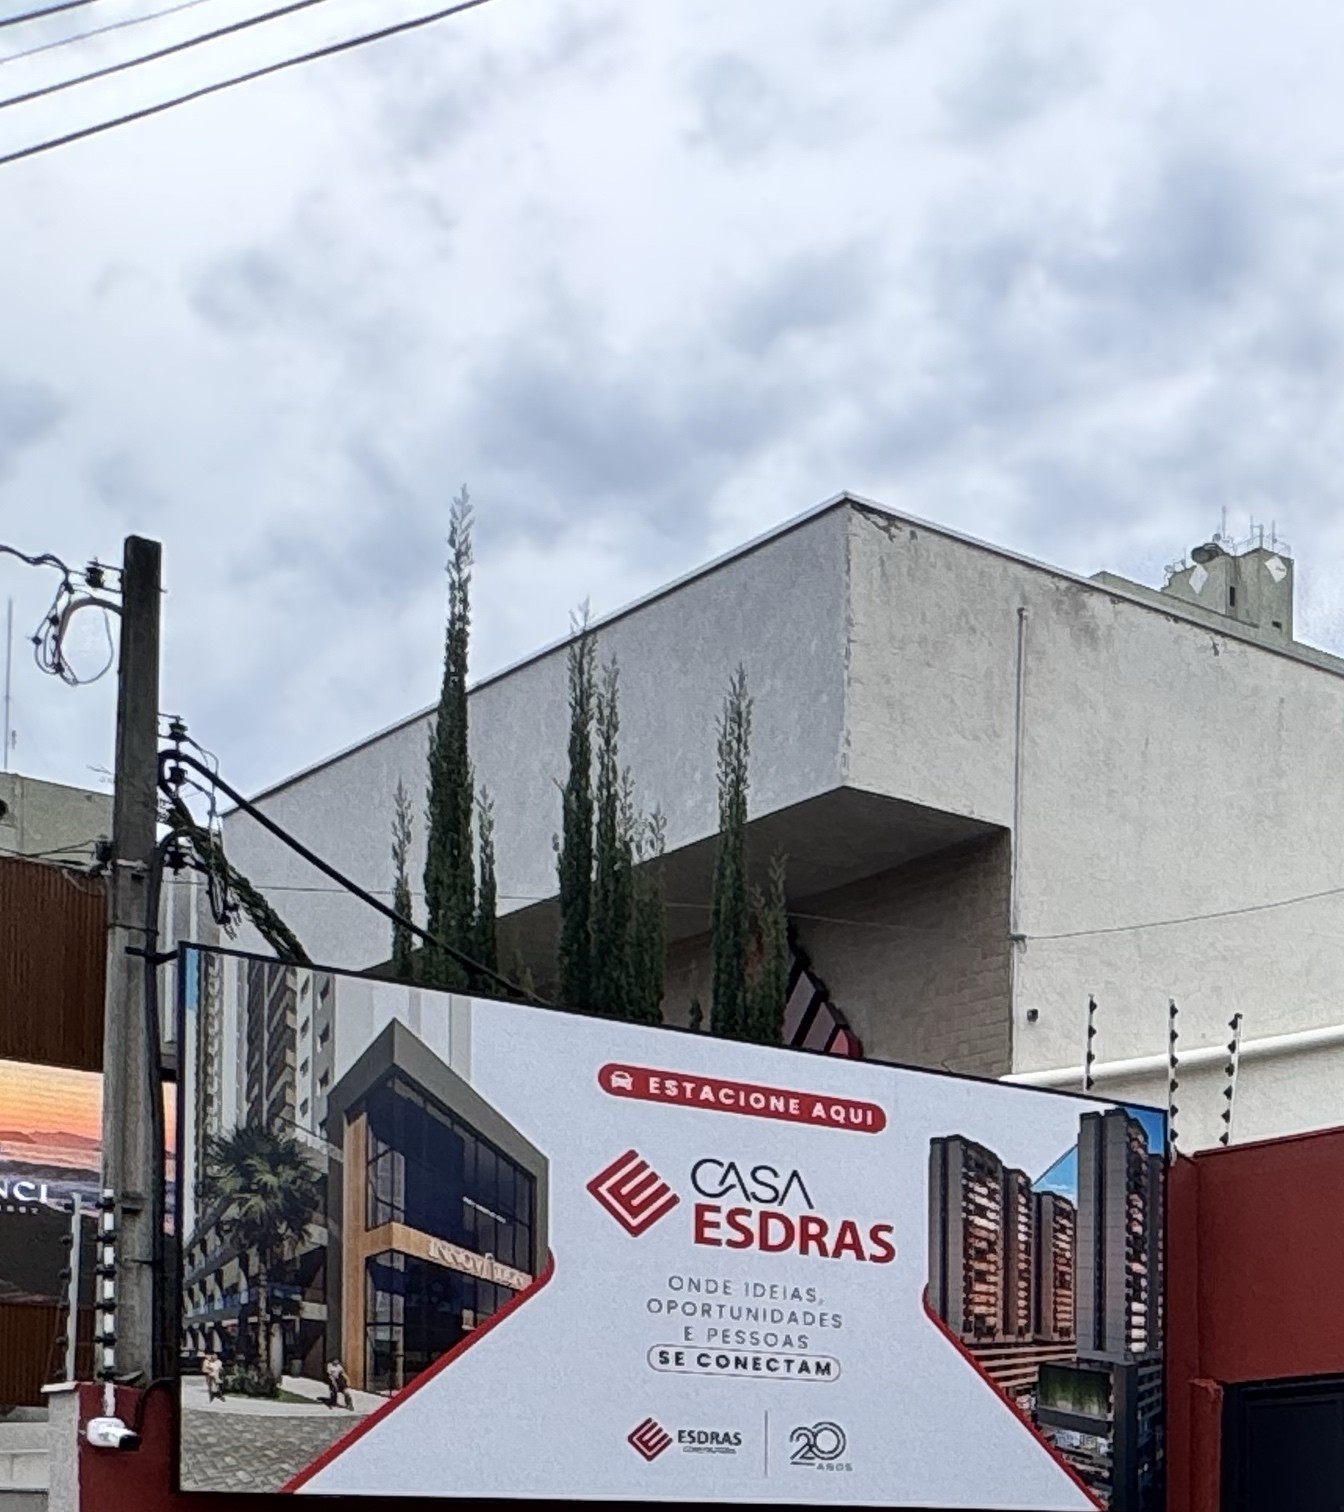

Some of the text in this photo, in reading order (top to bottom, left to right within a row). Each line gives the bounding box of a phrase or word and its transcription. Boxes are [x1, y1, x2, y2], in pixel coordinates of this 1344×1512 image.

[649, 1076, 873, 1126] ESTACIONE AQUI
[691, 1158, 815, 1210] CASA
[694, 1203, 896, 1263] ESDRAS
[668, 1275, 733, 1296] ONDE
[647, 1298, 843, 1329] OPORTUNIDADES
[684, 1326, 809, 1349] E PESSOAS
[658, 1350, 832, 1376] SE CONECTAM
[678, 1429, 742, 1447] ESDRAS
[790, 1421, 847, 1461] 20
